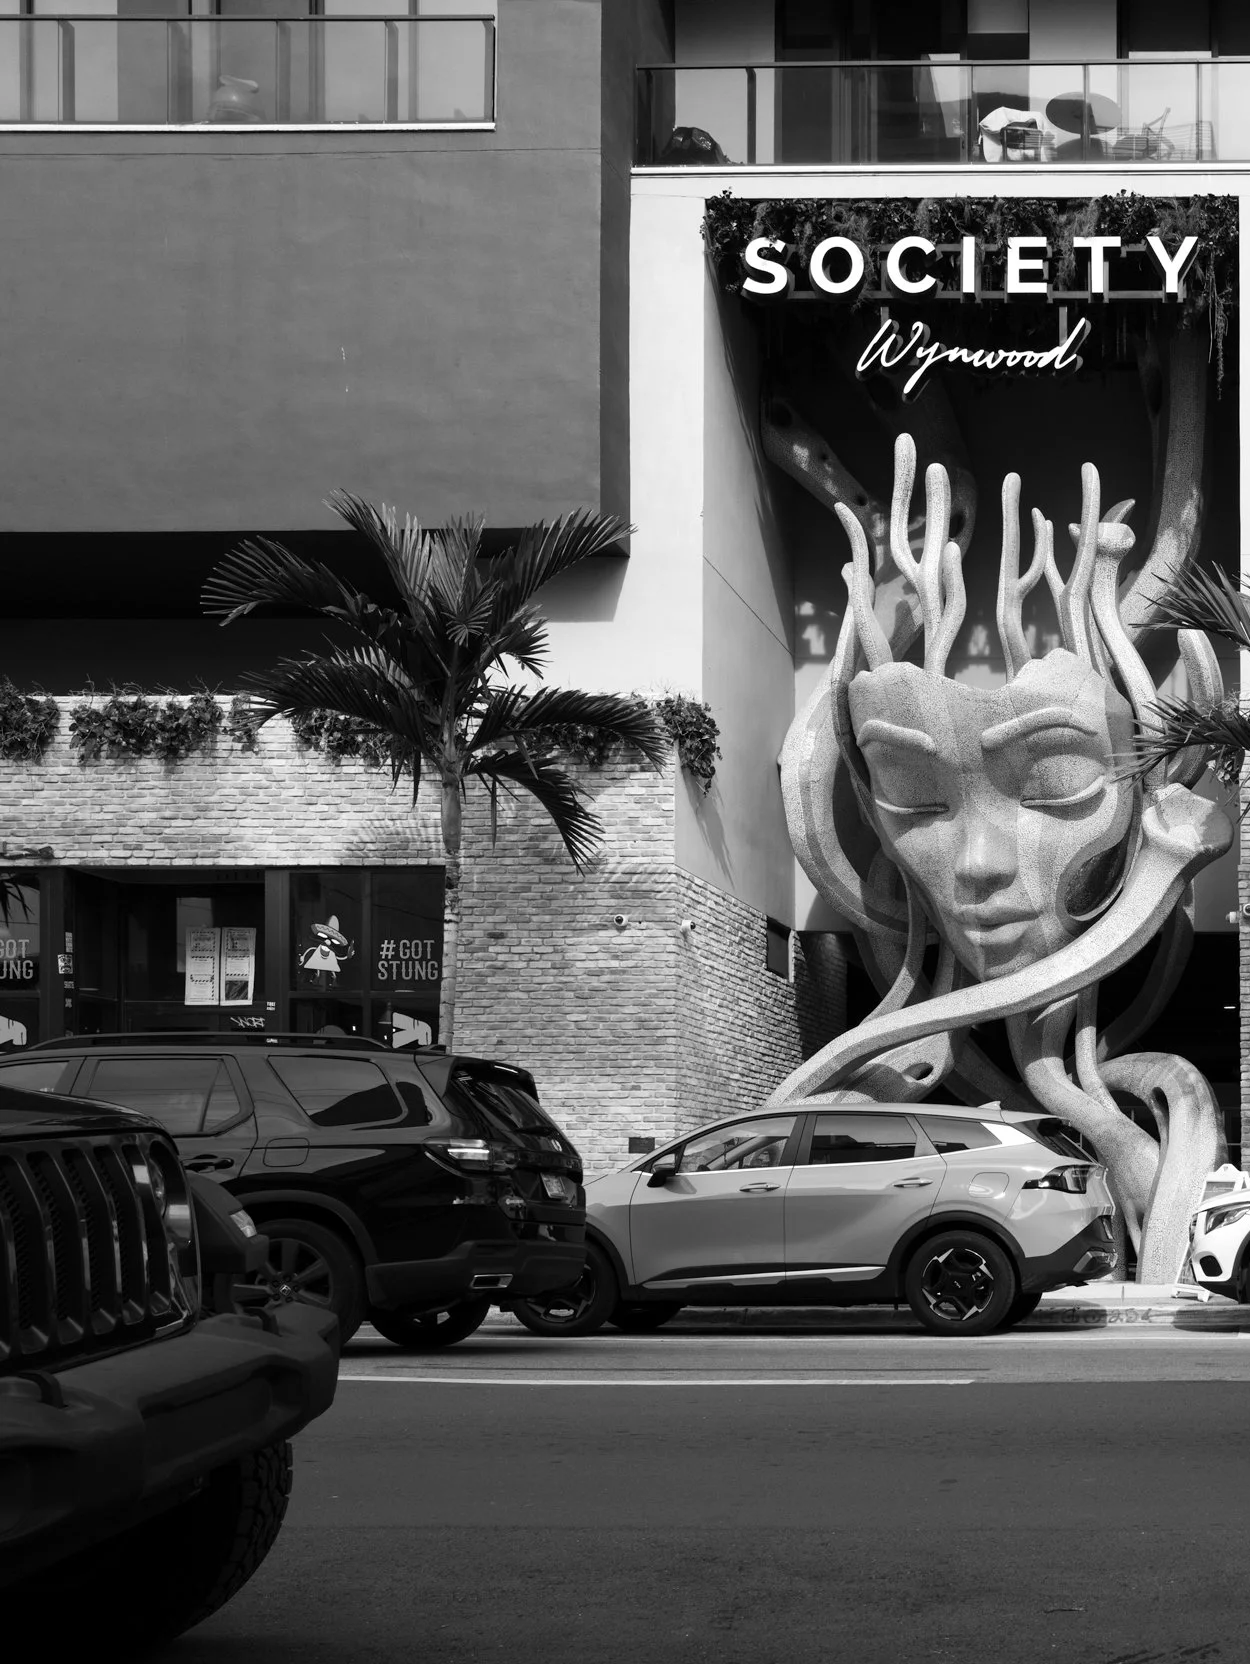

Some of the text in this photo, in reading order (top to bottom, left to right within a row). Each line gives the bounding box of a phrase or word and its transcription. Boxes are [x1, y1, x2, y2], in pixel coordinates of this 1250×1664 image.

[742, 236, 1198, 294] SOCIETY
[856, 318, 1086, 394] Wynwood
[379, 939, 435, 959] #GOT
[377, 960, 439, 980] STUNG
